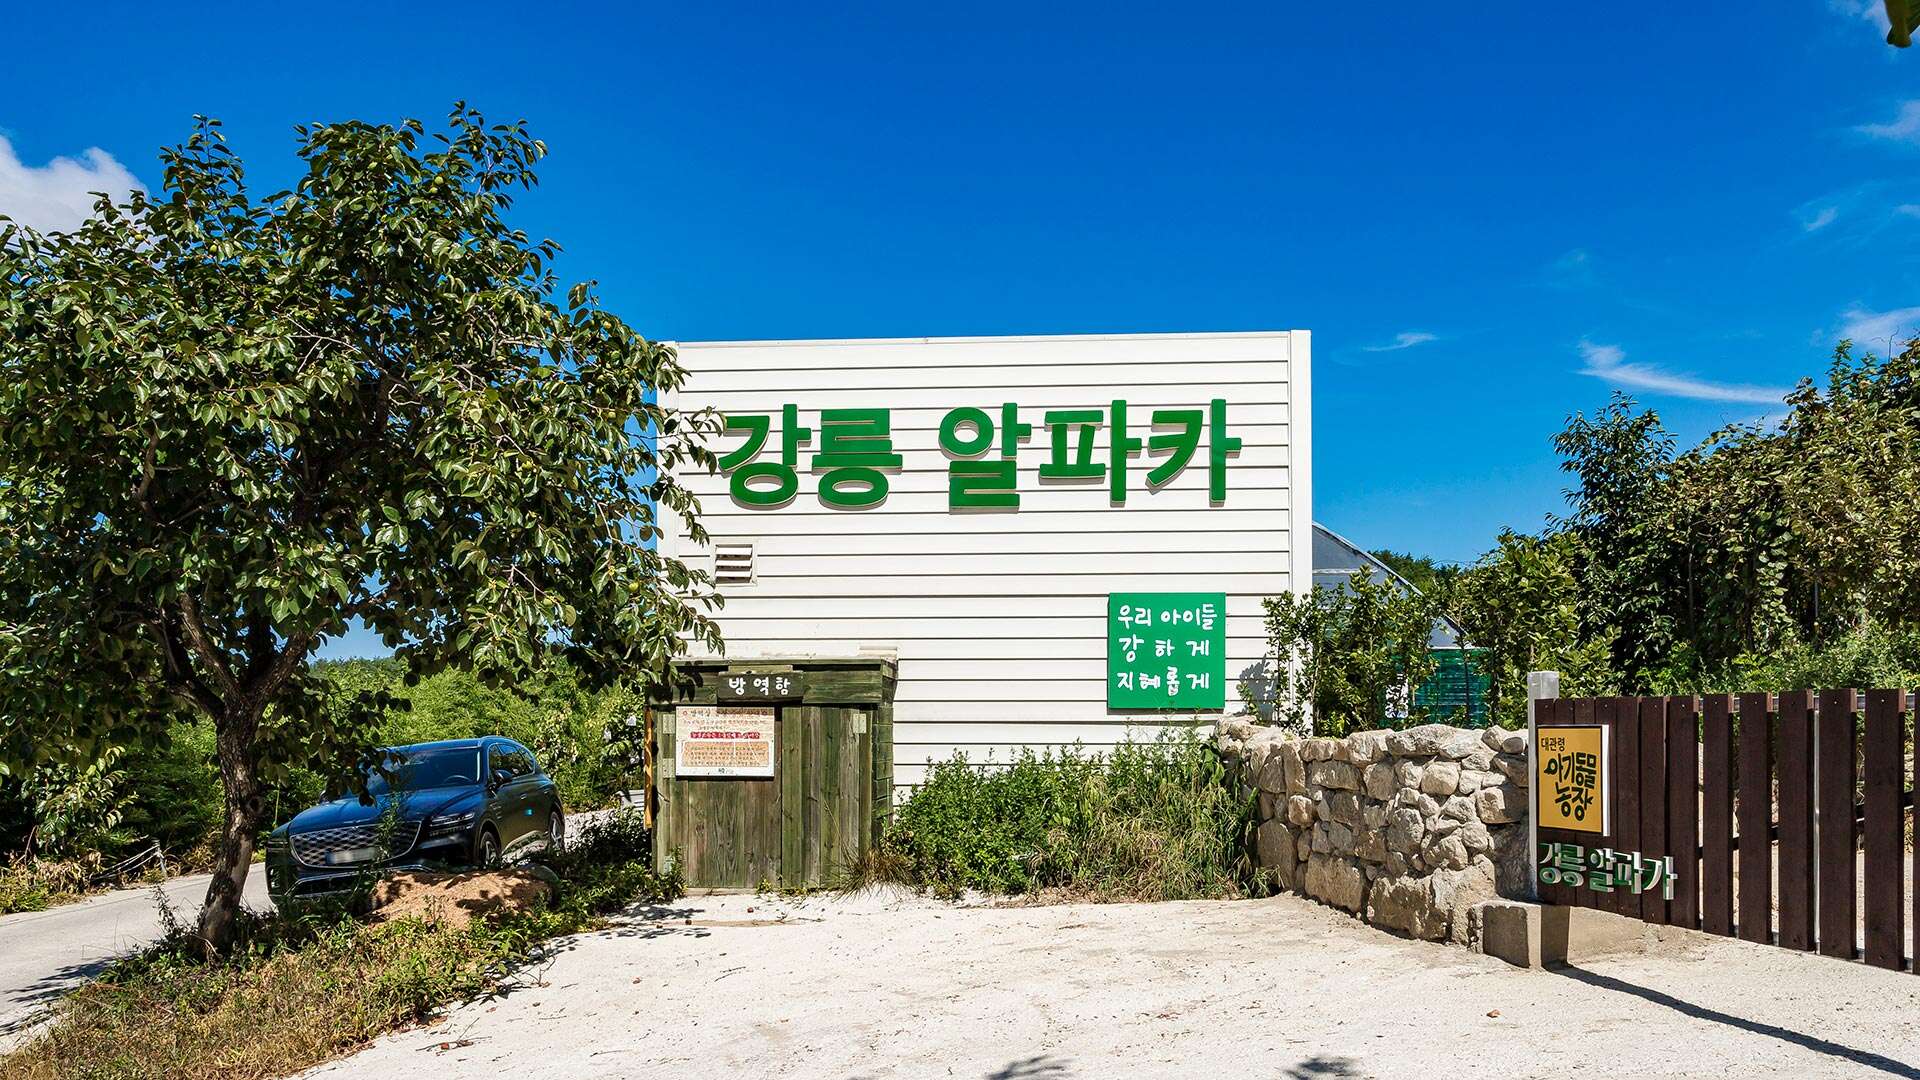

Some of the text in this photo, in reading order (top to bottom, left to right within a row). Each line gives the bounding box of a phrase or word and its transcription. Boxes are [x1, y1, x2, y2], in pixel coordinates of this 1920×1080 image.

[717, 399, 1242, 514] 강릉 알파카
[1117, 603, 1218, 631] 우리 아이들
[1541, 737, 1566, 752] 대관령
[1543, 751, 1597, 790] 아기동물
[1554, 781, 1594, 822] 농장
[1539, 842, 1587, 888] 강릉
